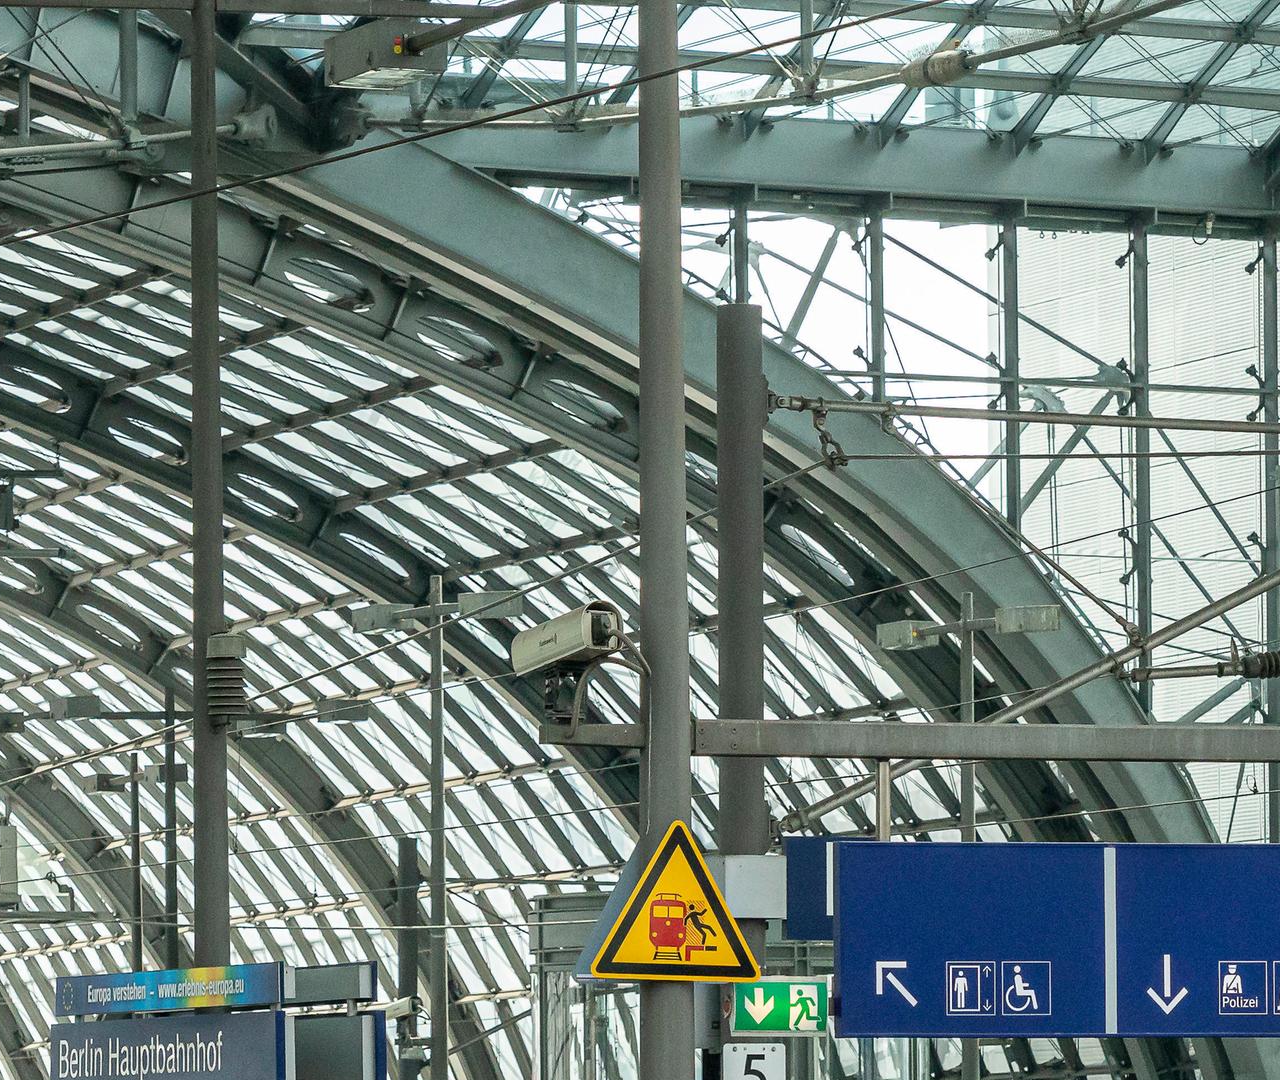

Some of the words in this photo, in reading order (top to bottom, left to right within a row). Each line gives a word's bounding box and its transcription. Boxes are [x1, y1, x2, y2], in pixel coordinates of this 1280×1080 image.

[87, 984, 112, 1005] Europa
[113, 981, 146, 1001] verstehen
[157, 978, 245, 1000] www.erlebnis-europa.eu
[1222, 996, 1259, 1008] Polizei
[58, 1038, 103, 1079] Berlin
